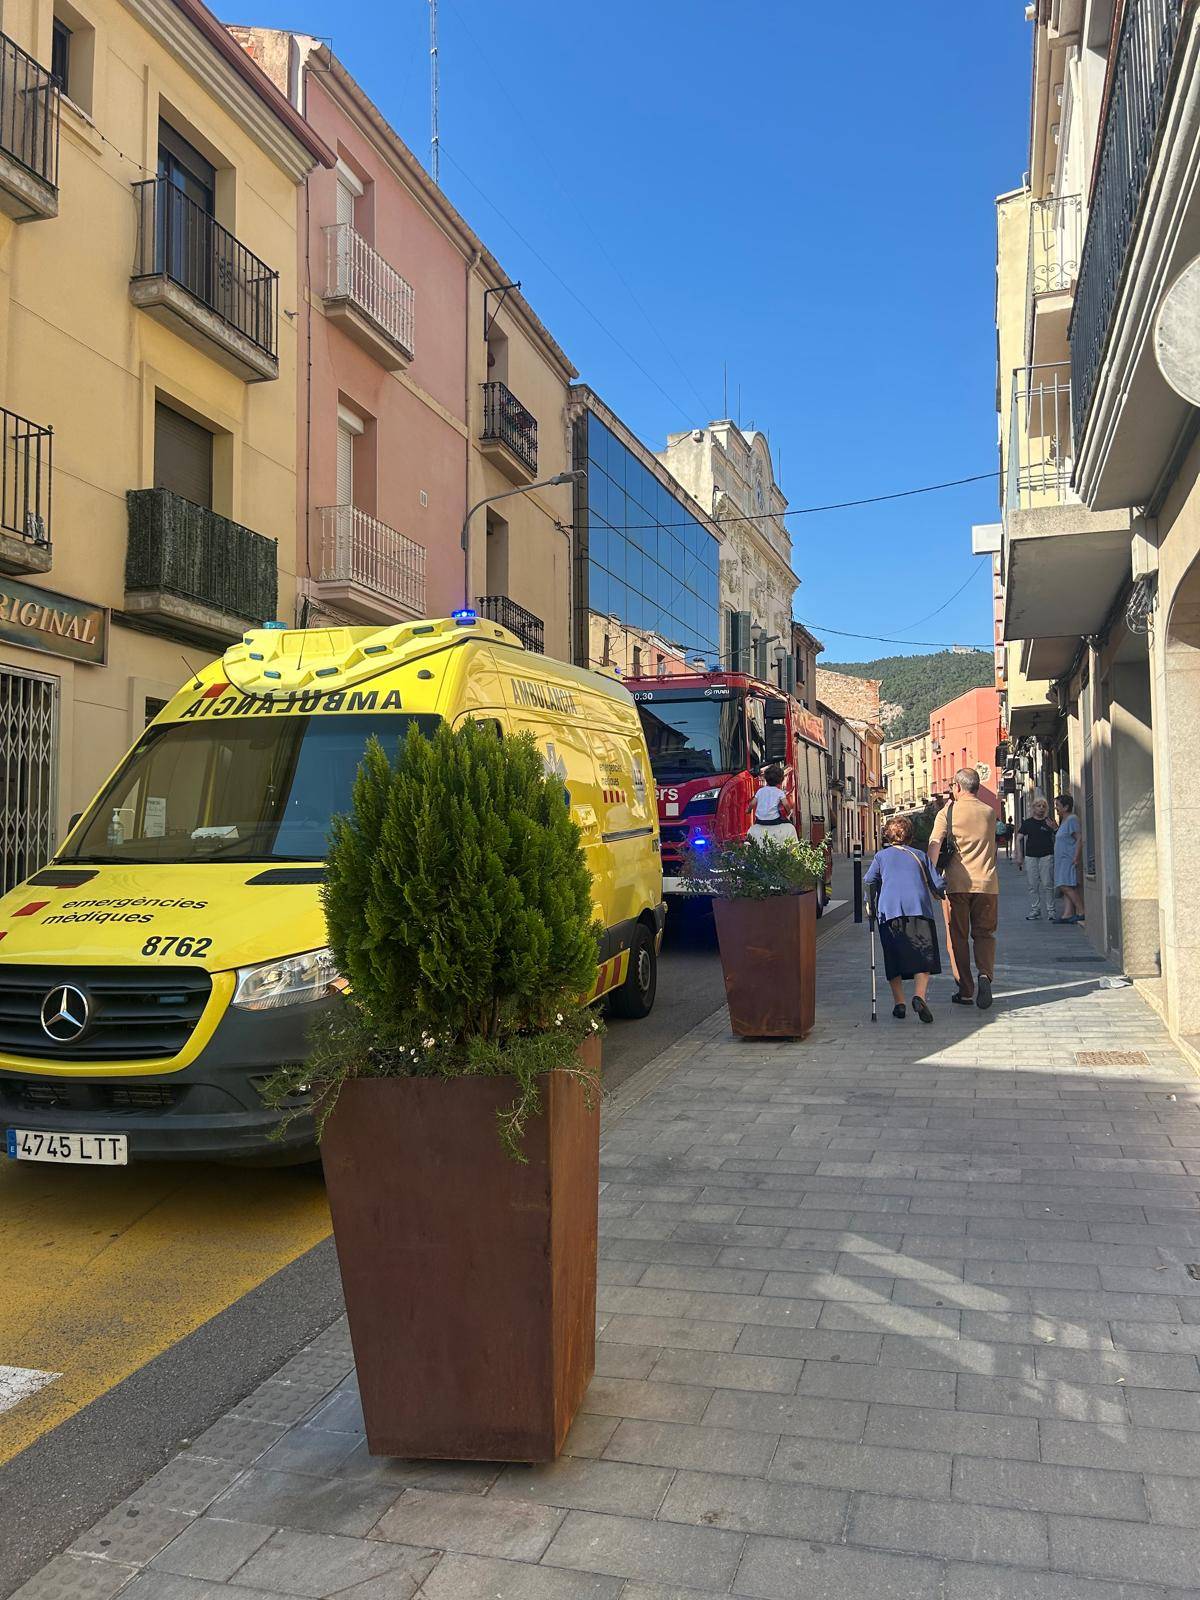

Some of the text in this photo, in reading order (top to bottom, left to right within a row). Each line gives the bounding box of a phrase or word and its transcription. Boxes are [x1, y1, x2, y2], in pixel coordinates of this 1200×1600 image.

[62, 896, 208, 909] emergències
[40, 910, 154, 925] mèdiques
[141, 935, 213, 958] 8762
[21, 1133, 72, 1158] 4745
[80, 1137, 120, 1160] LTT
